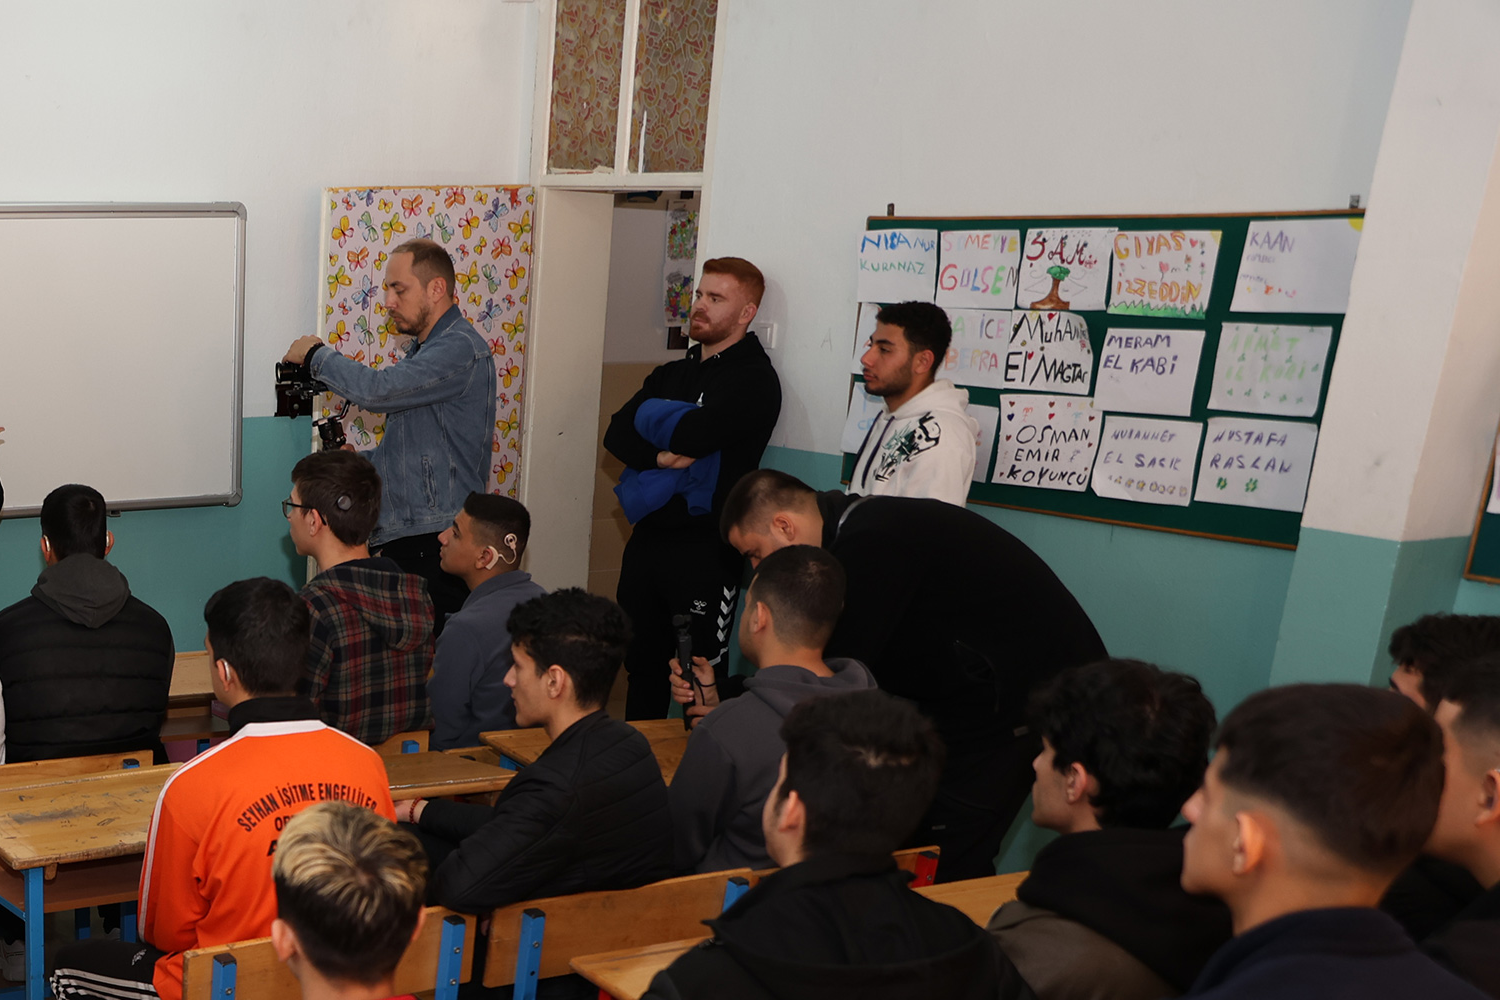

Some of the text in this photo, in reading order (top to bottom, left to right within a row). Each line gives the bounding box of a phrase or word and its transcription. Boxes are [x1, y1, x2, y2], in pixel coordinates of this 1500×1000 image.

[1249, 230, 1295, 253] KAAN
[1106, 333, 1171, 350] MERAM
[1103, 354, 1123, 370] EL
[1015, 424, 1090, 446] OSMAN
[1103, 450, 1124, 464] EL
[237, 793, 280, 833] SEYHAN
[275, 782, 316, 808] İŞİTME
